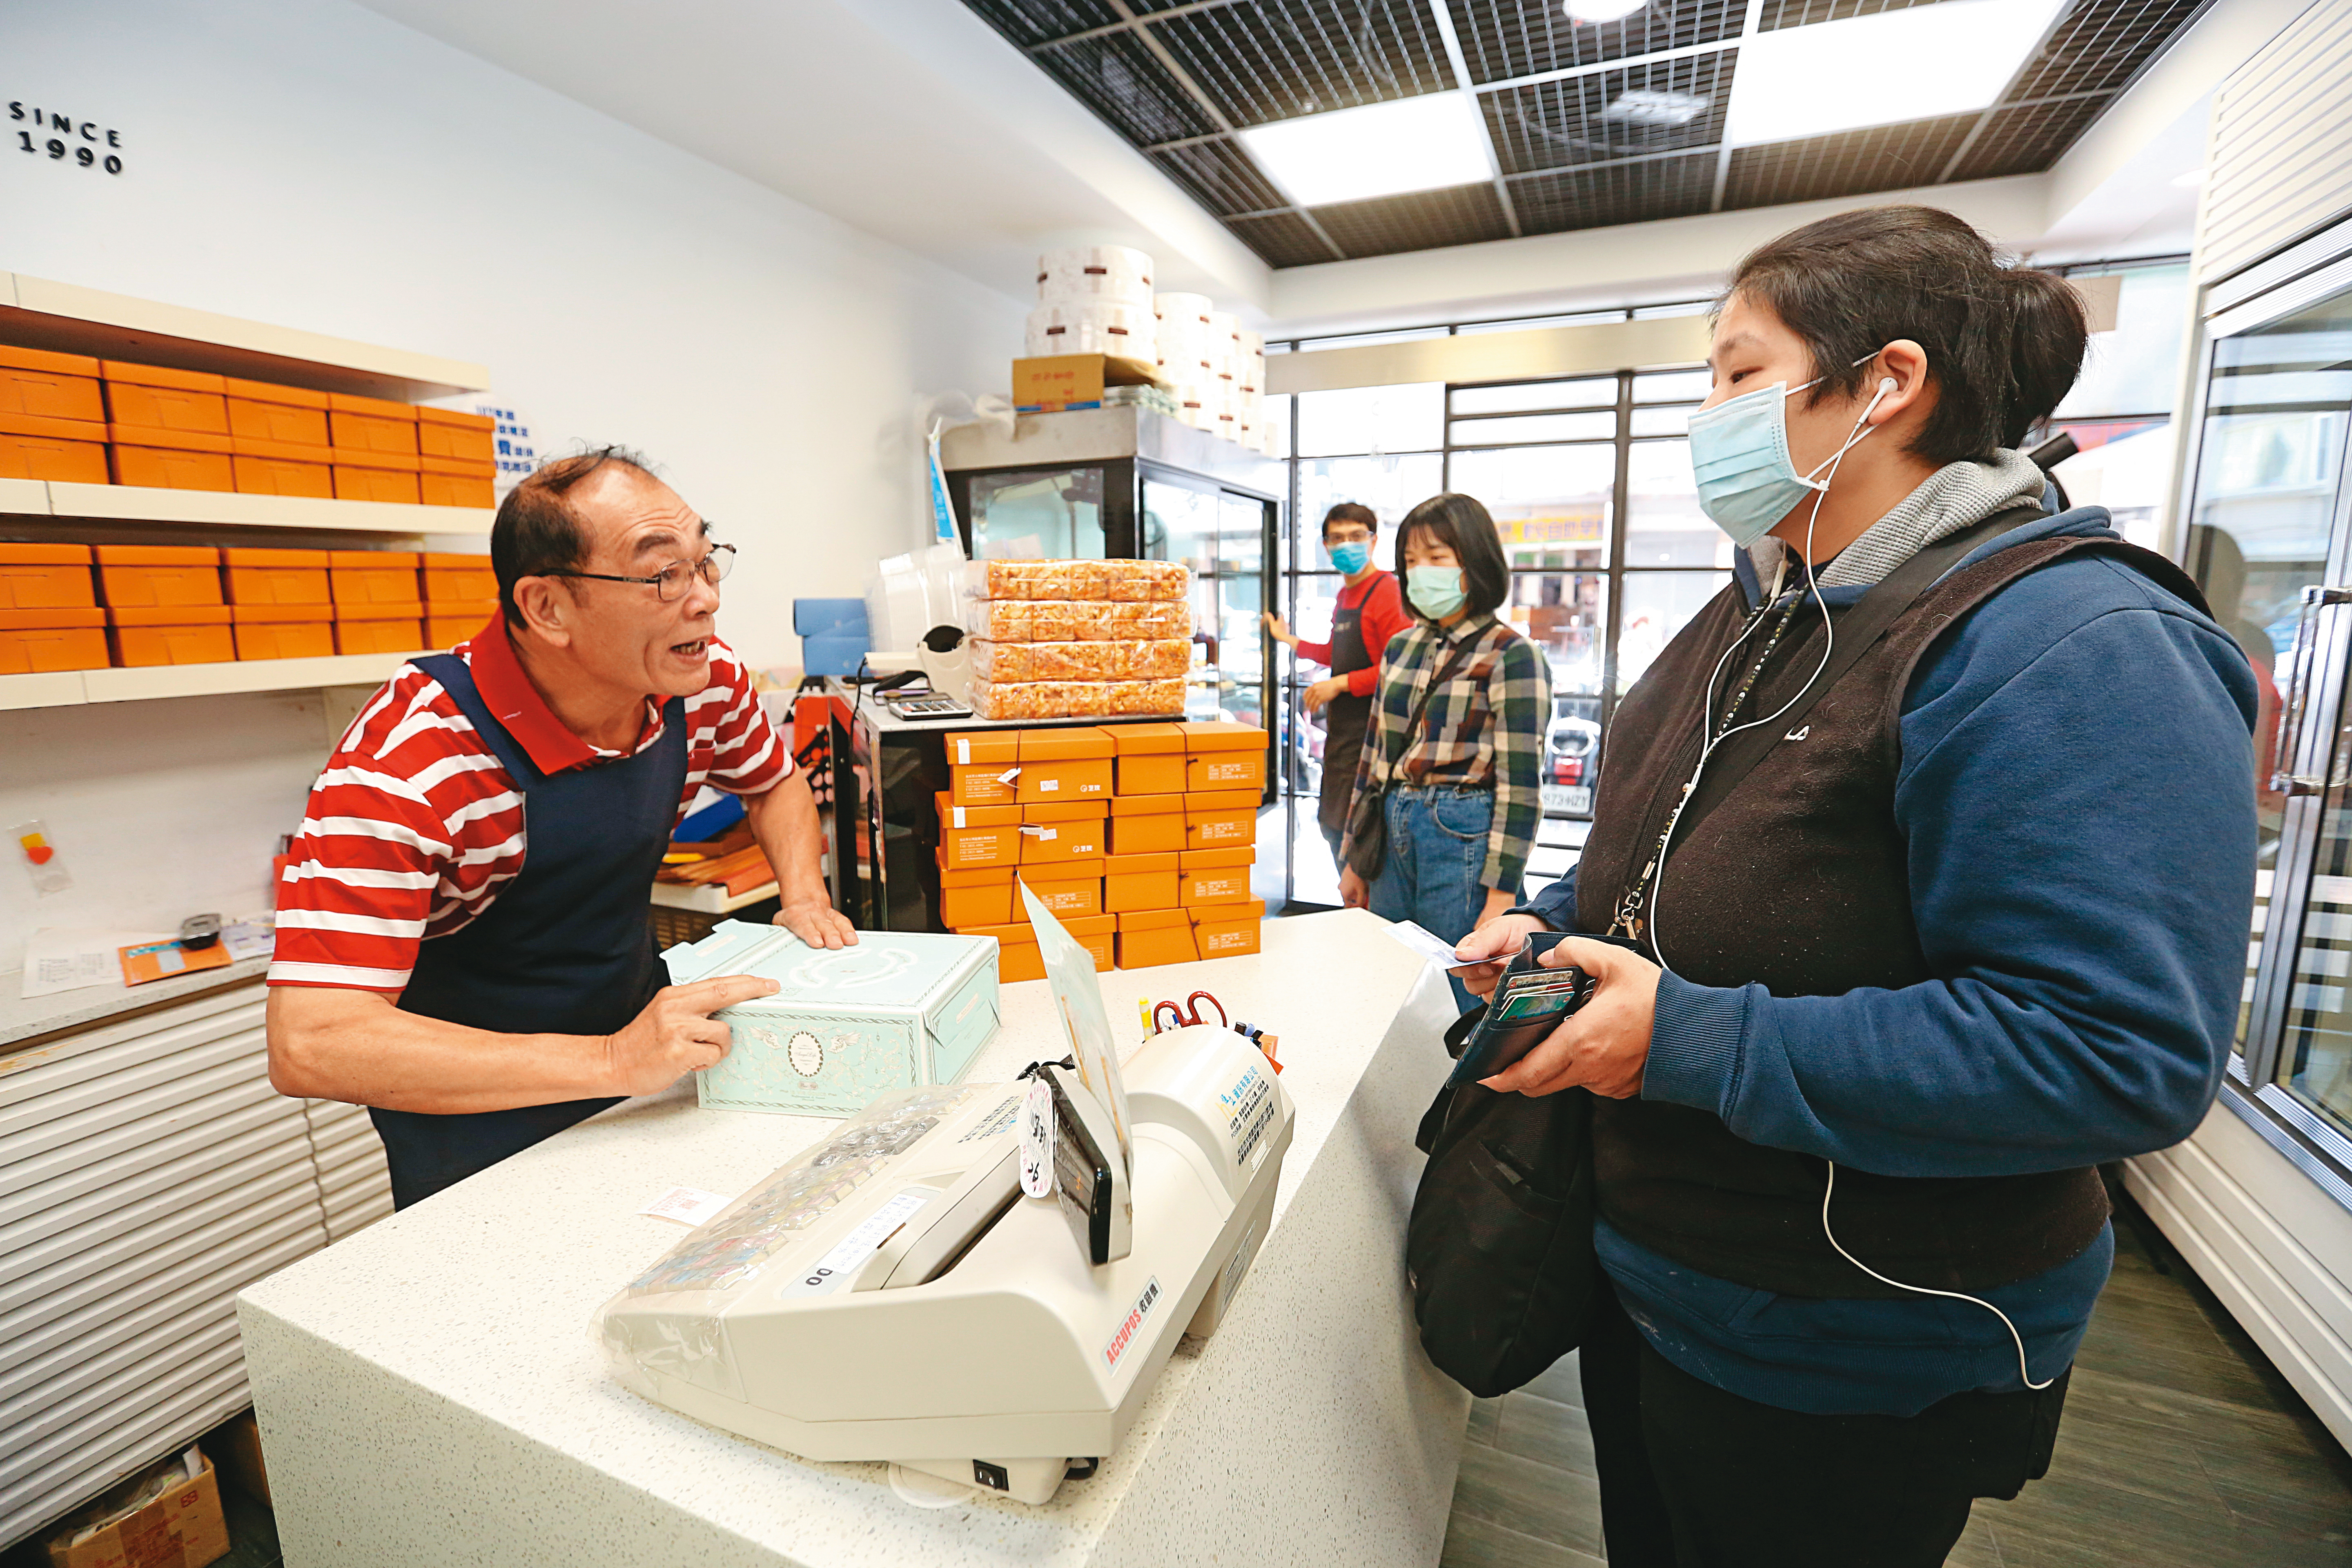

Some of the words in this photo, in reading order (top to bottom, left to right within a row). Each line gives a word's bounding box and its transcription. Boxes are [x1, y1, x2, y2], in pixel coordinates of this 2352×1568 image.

[9, 101, 122, 148] SINCE
[18, 131, 122, 175] 1990
[1139, 1283, 1158, 1314] 收銀機
[1106, 1309, 1142, 1365] ACCUPOS
